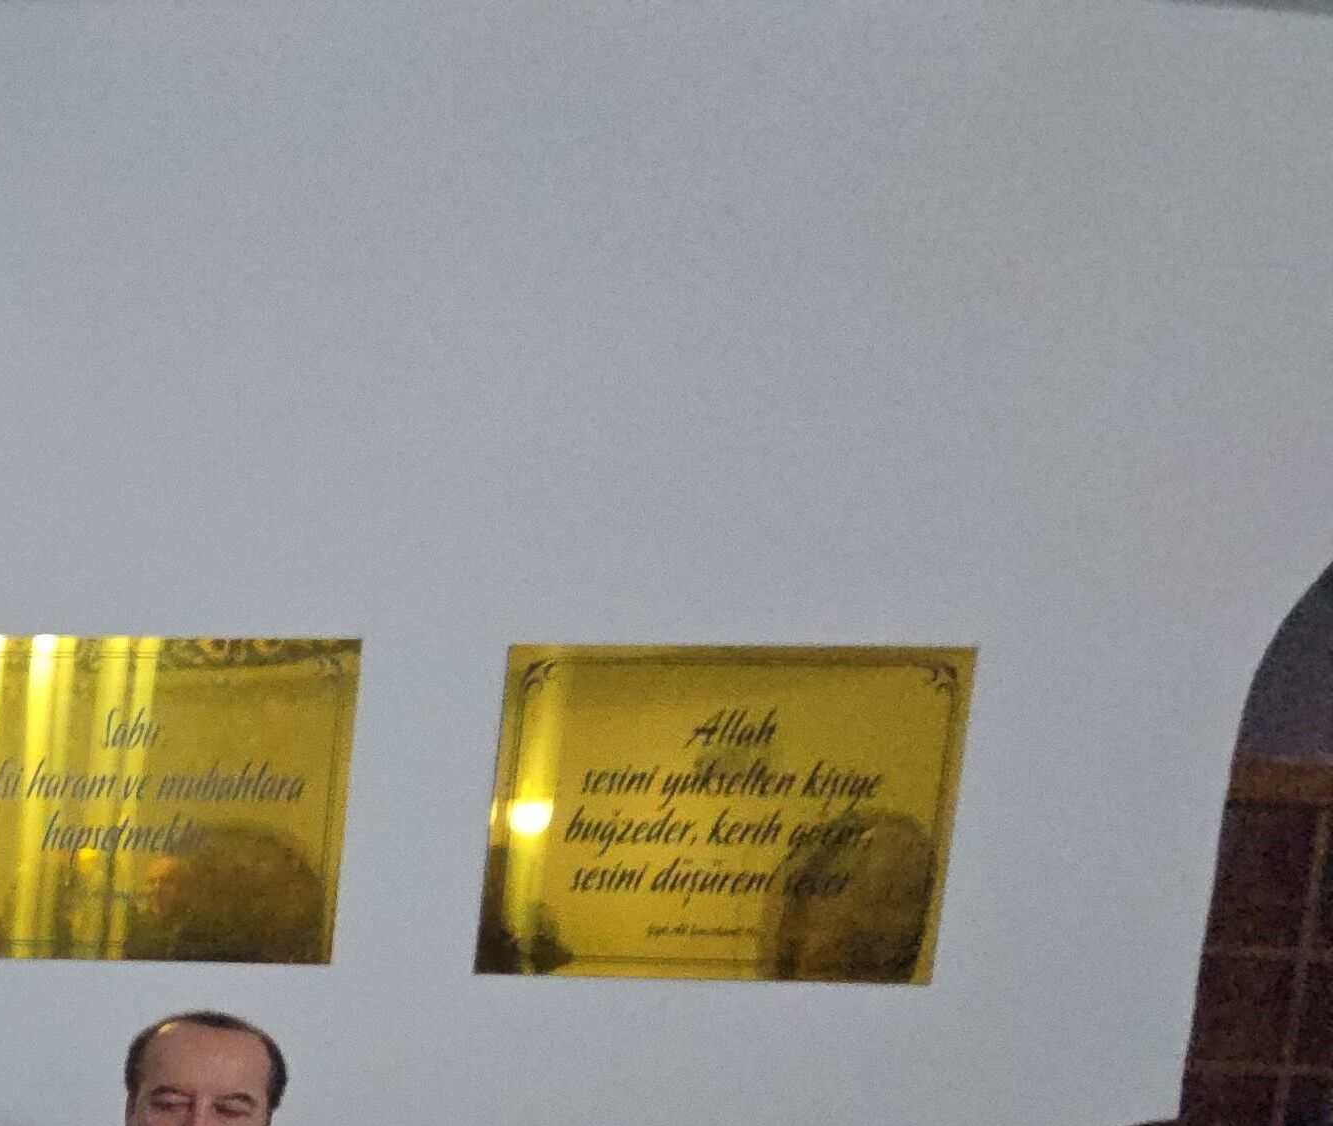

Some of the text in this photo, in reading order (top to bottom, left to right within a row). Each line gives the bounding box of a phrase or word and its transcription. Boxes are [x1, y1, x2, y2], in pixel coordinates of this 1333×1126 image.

[683, 707, 777, 748] Allah
[26, 756, 117, 800] haram
[564, 804, 699, 858] buğzeder,
